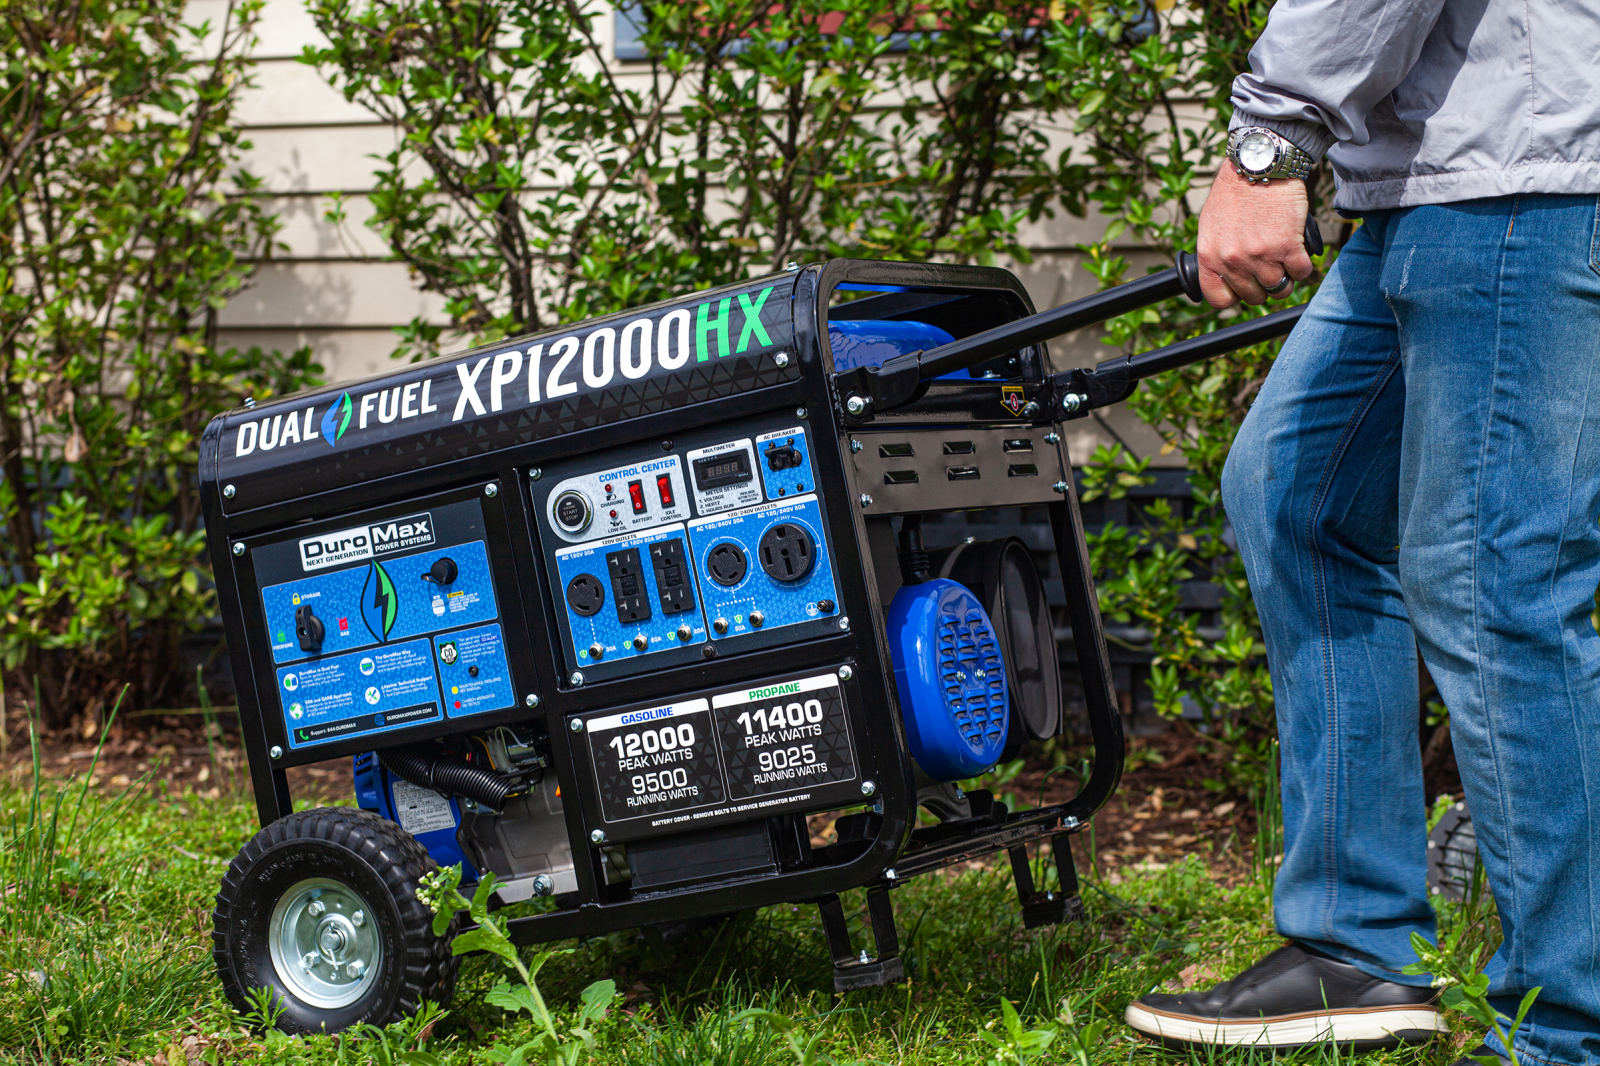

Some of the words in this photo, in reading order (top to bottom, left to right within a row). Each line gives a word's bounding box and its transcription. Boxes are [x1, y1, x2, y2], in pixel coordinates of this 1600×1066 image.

[236, 407, 319, 457] DUAL
[359, 381, 438, 430] FUEL
[451, 286, 775, 421] XP12000HX
[771, 429, 797, 439] BREAKER
[702, 443, 736, 454] MULTIMETER
[598, 467, 640, 483] CONTROL
[641, 459, 676, 474] CENTER
[705, 488, 723, 497] METER
[723, 482, 749, 492] SETTINGS
[600, 499, 625, 508] CHARGING
[704, 494, 725, 502] VOLTAGE
[562, 508, 579, 516] START
[705, 505, 723, 514] HOURS
[754, 503, 778, 512] OUTLETS
[564, 514, 579, 522] STOP
[631, 515, 653, 524] BATTERY
[660, 513, 683, 522] CONTROL
[303, 520, 430, 559] DuroMax
[375, 542, 400, 553] POWER
[400, 535, 432, 547] SYSTEMS
[614, 534, 638, 542] OUTLETS
[306, 558, 324, 566] NEXT
[325, 548, 369, 562] GENERATION
[301, 591, 321, 601] STORAGE
[273, 642, 294, 650] PROPANE
[444, 647, 453, 657] CO
[397, 678, 416, 687] Technical
[415, 675, 433, 684] Support
[748, 682, 801, 701] PROPANE
[386, 707, 433, 721] DUROMAXPOWER.COM
[621, 706, 674, 725] GASOLINE
[736, 699, 824, 736] 11400
[608, 723, 697, 759] 12000
[744, 734, 778, 749] PEAK
[778, 724, 822, 742] WATTS
[617, 757, 651, 772] PEAK
[652, 748, 694, 765] WATTS
[758, 744, 816, 772] 9025
[631, 767, 688, 795] 9500
[753, 769, 796, 785] RUNNING
[796, 762, 828, 778] WATTS
[626, 792, 668, 808] RUNNING
[668, 786, 699, 800] WATTS
[652, 819, 673, 827] BATTERY
[673, 815, 691, 823] COVER
[692, 811, 713, 820] REMOVE
[714, 808, 730, 816] BOLTS
[737, 803, 758, 812] SERVICE
[758, 798, 787, 809] GENERATOR
[788, 794, 811, 803] BATTERY
